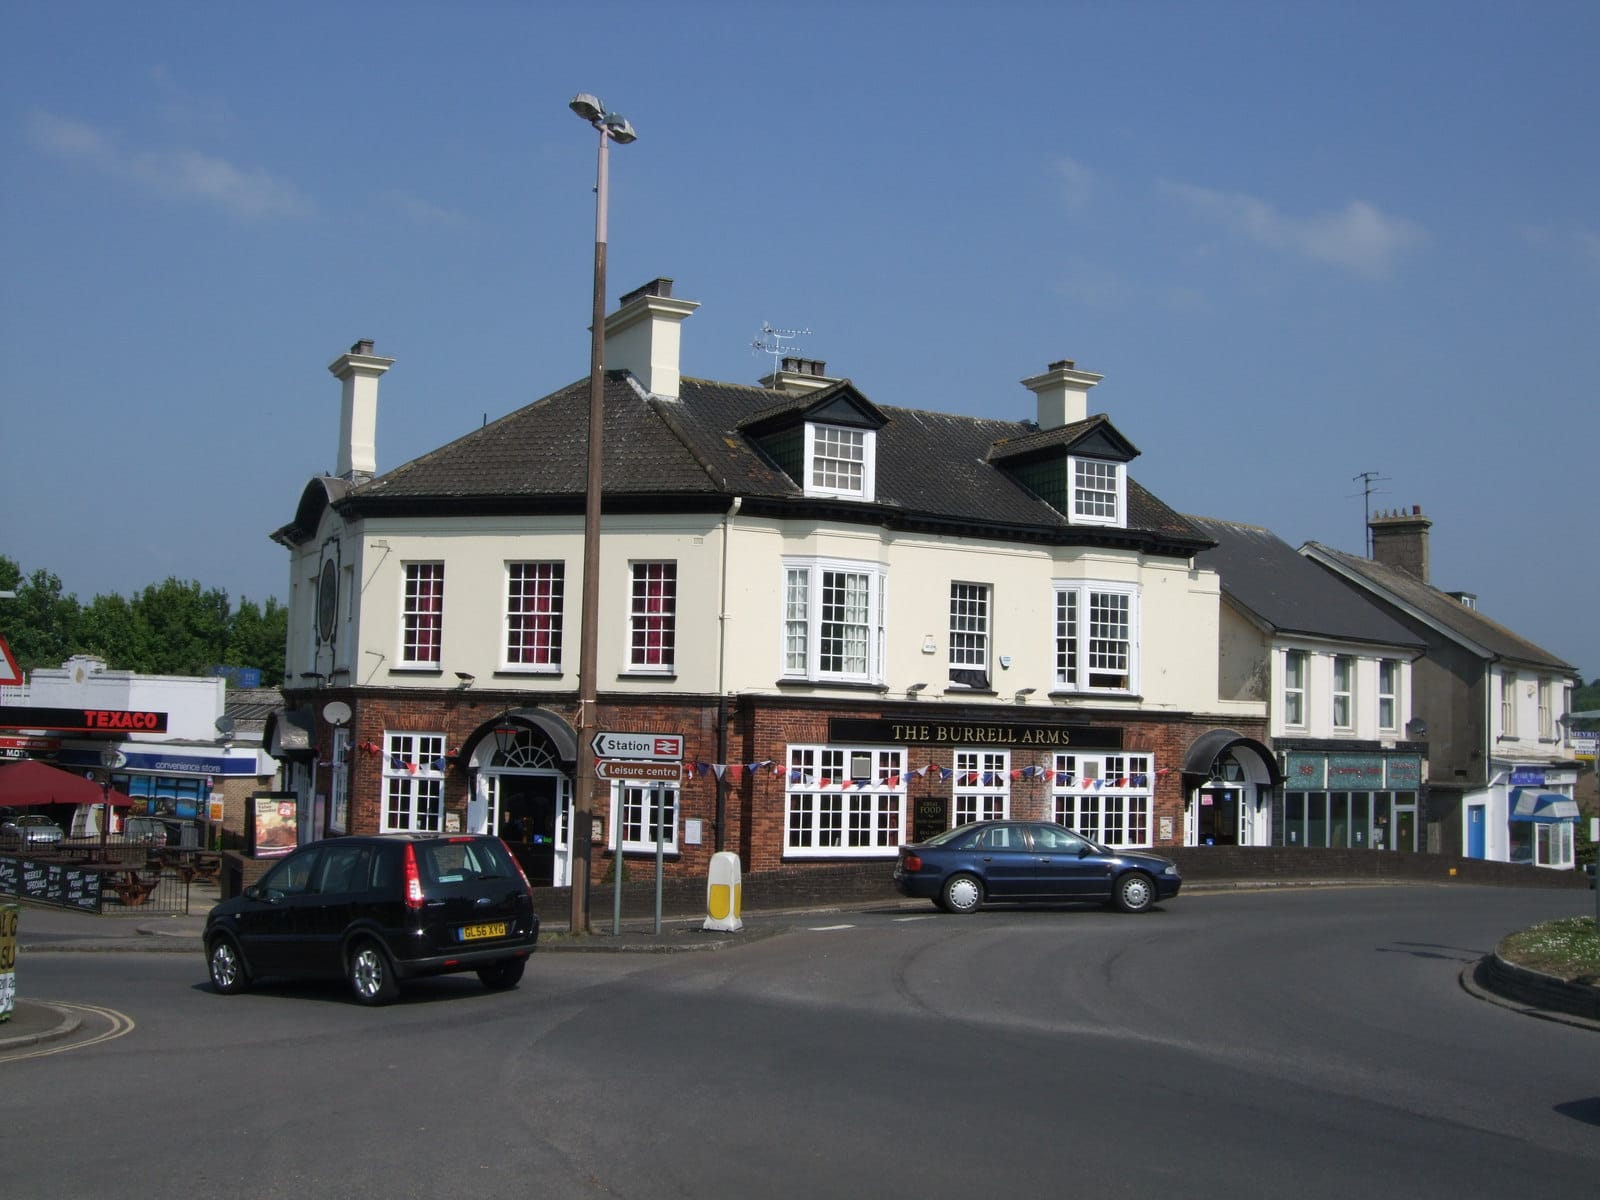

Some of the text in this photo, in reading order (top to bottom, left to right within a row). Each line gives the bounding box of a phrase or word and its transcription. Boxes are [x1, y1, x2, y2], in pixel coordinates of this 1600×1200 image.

[84, 711, 157, 728] TEXACO
[892, 725, 1070, 744] THE BURRELL ARMS
[608, 740, 650, 751] Station
[155, 762, 221, 773] convenience store
[609, 766, 677, 777] Leisure centre
[920, 806, 942, 814] FOOD
